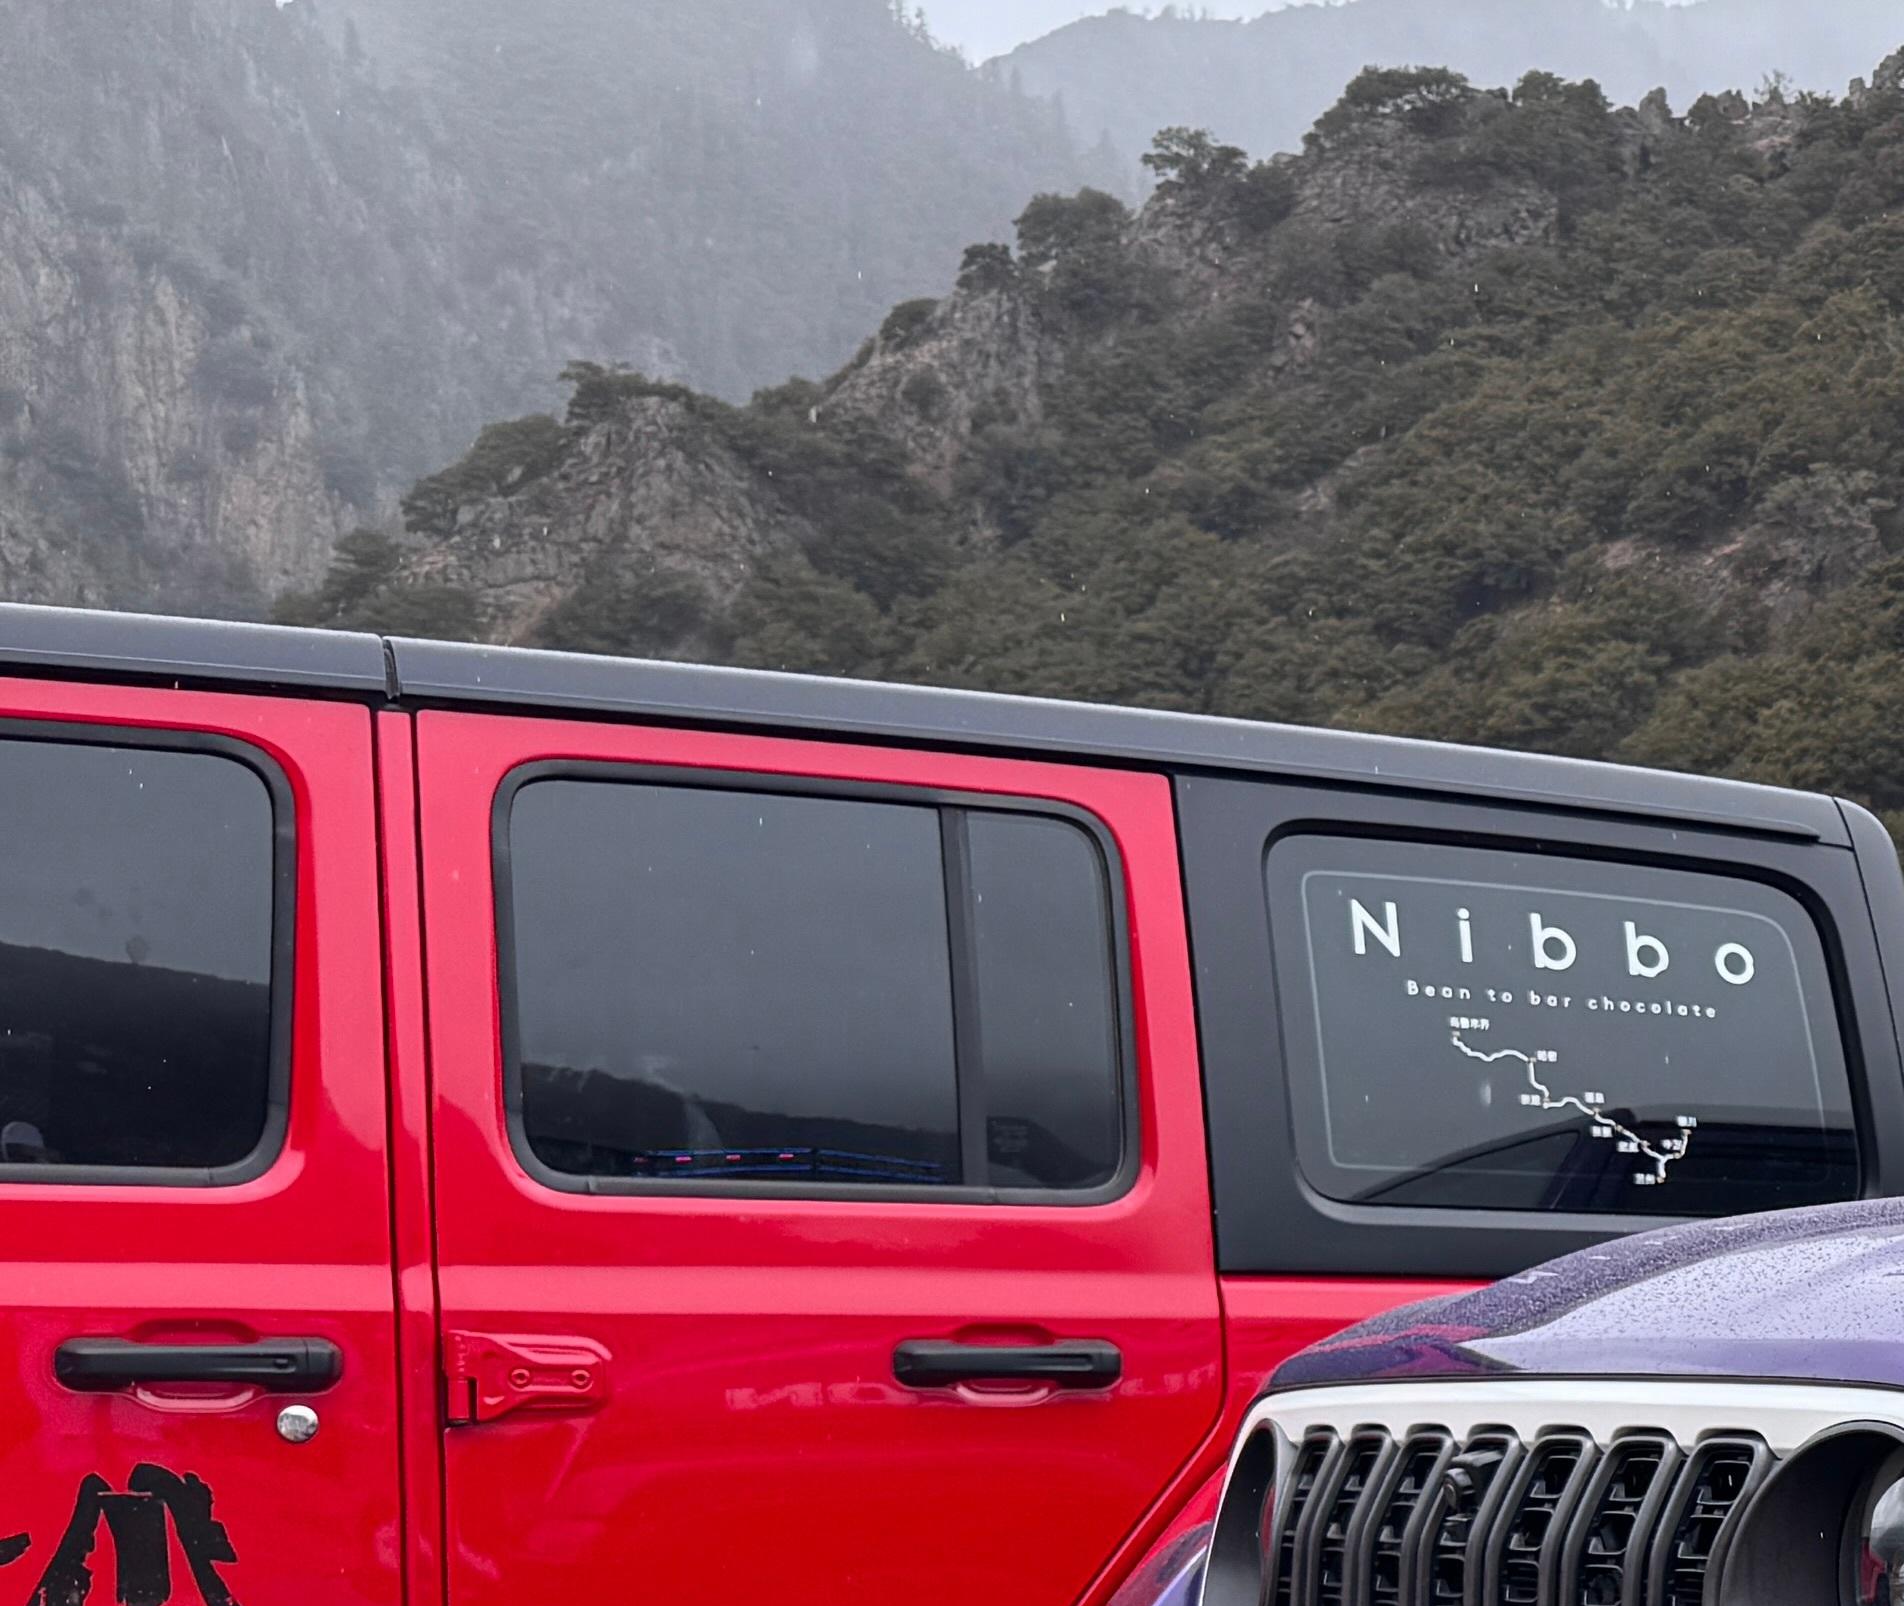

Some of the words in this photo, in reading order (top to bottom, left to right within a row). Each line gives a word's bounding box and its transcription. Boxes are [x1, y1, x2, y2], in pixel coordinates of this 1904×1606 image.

[1348, 898, 1755, 985] Nibbo
[1407, 979, 1471, 1000] Bean
[1487, 988, 1513, 1003] to
[1529, 990, 1572, 1008] bar
[1588, 996, 1717, 1018] chocolate
